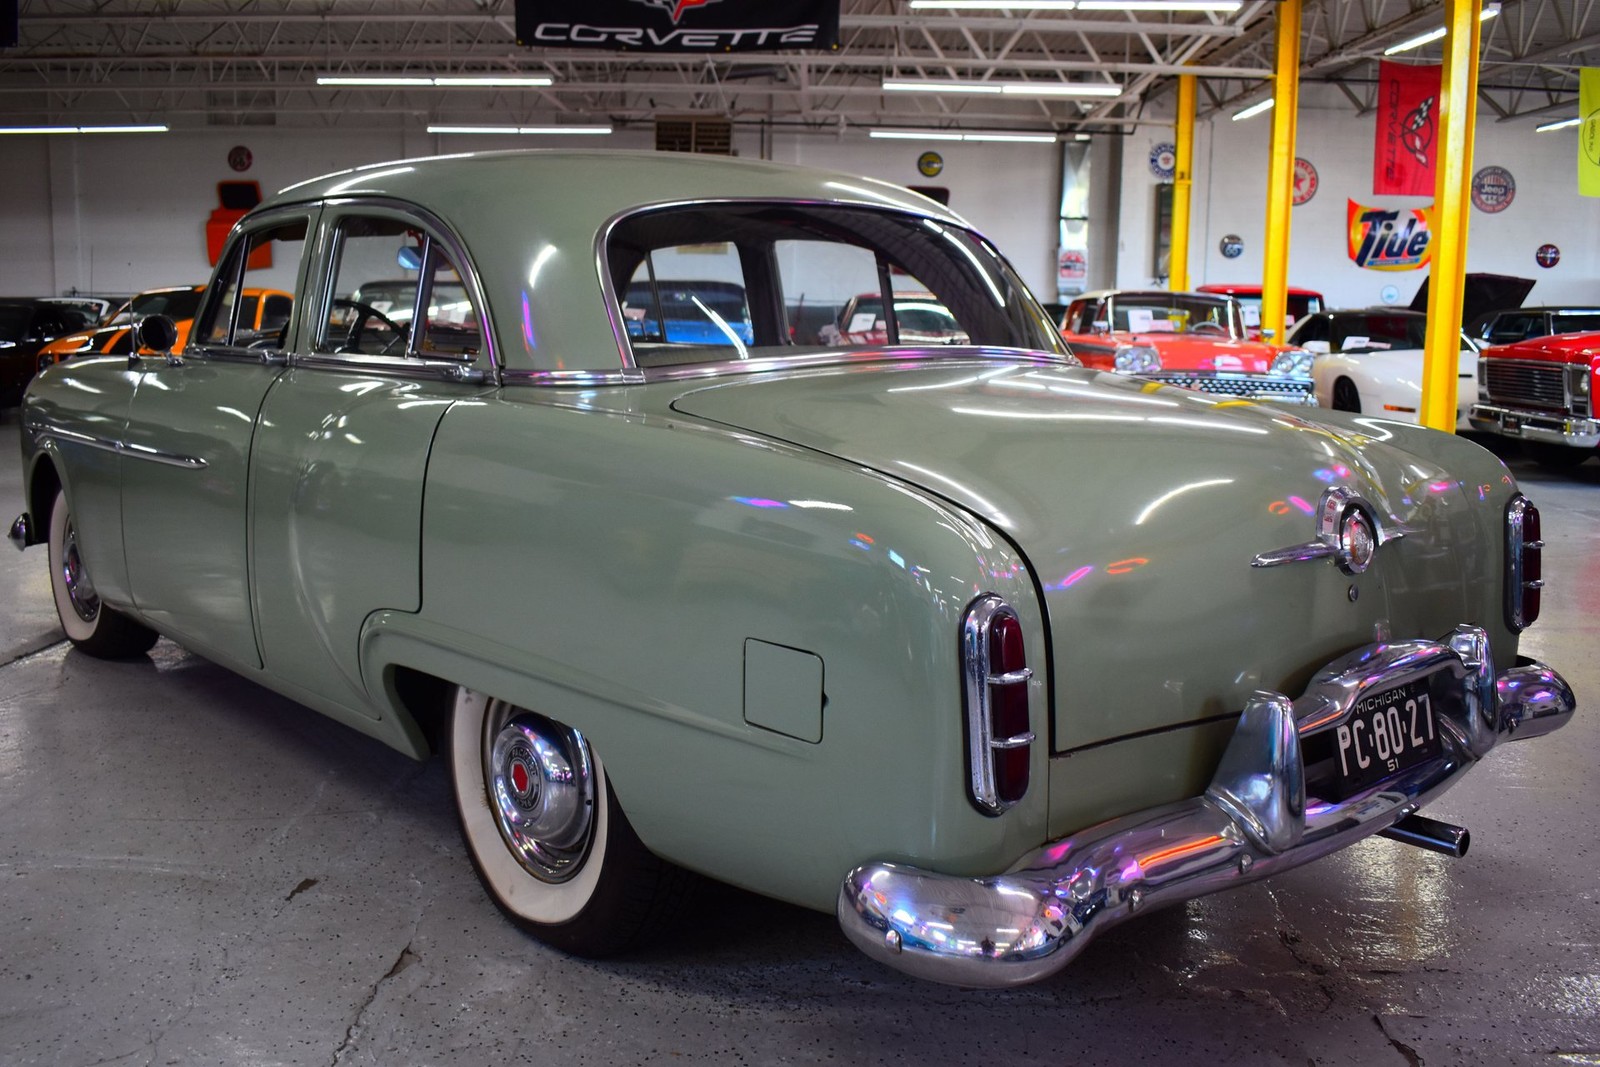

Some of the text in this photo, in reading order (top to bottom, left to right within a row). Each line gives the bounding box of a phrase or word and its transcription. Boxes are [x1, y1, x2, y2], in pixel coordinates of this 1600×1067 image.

[534, 23, 819, 46] CORVETTE
[1385, 79, 1400, 181] CORVETTE
[1481, 184, 1505, 194] Jeep
[1355, 210, 1430, 267] Tide
[1356, 687, 1407, 714] MICHIGAN
[1387, 758, 1399, 772] 51
